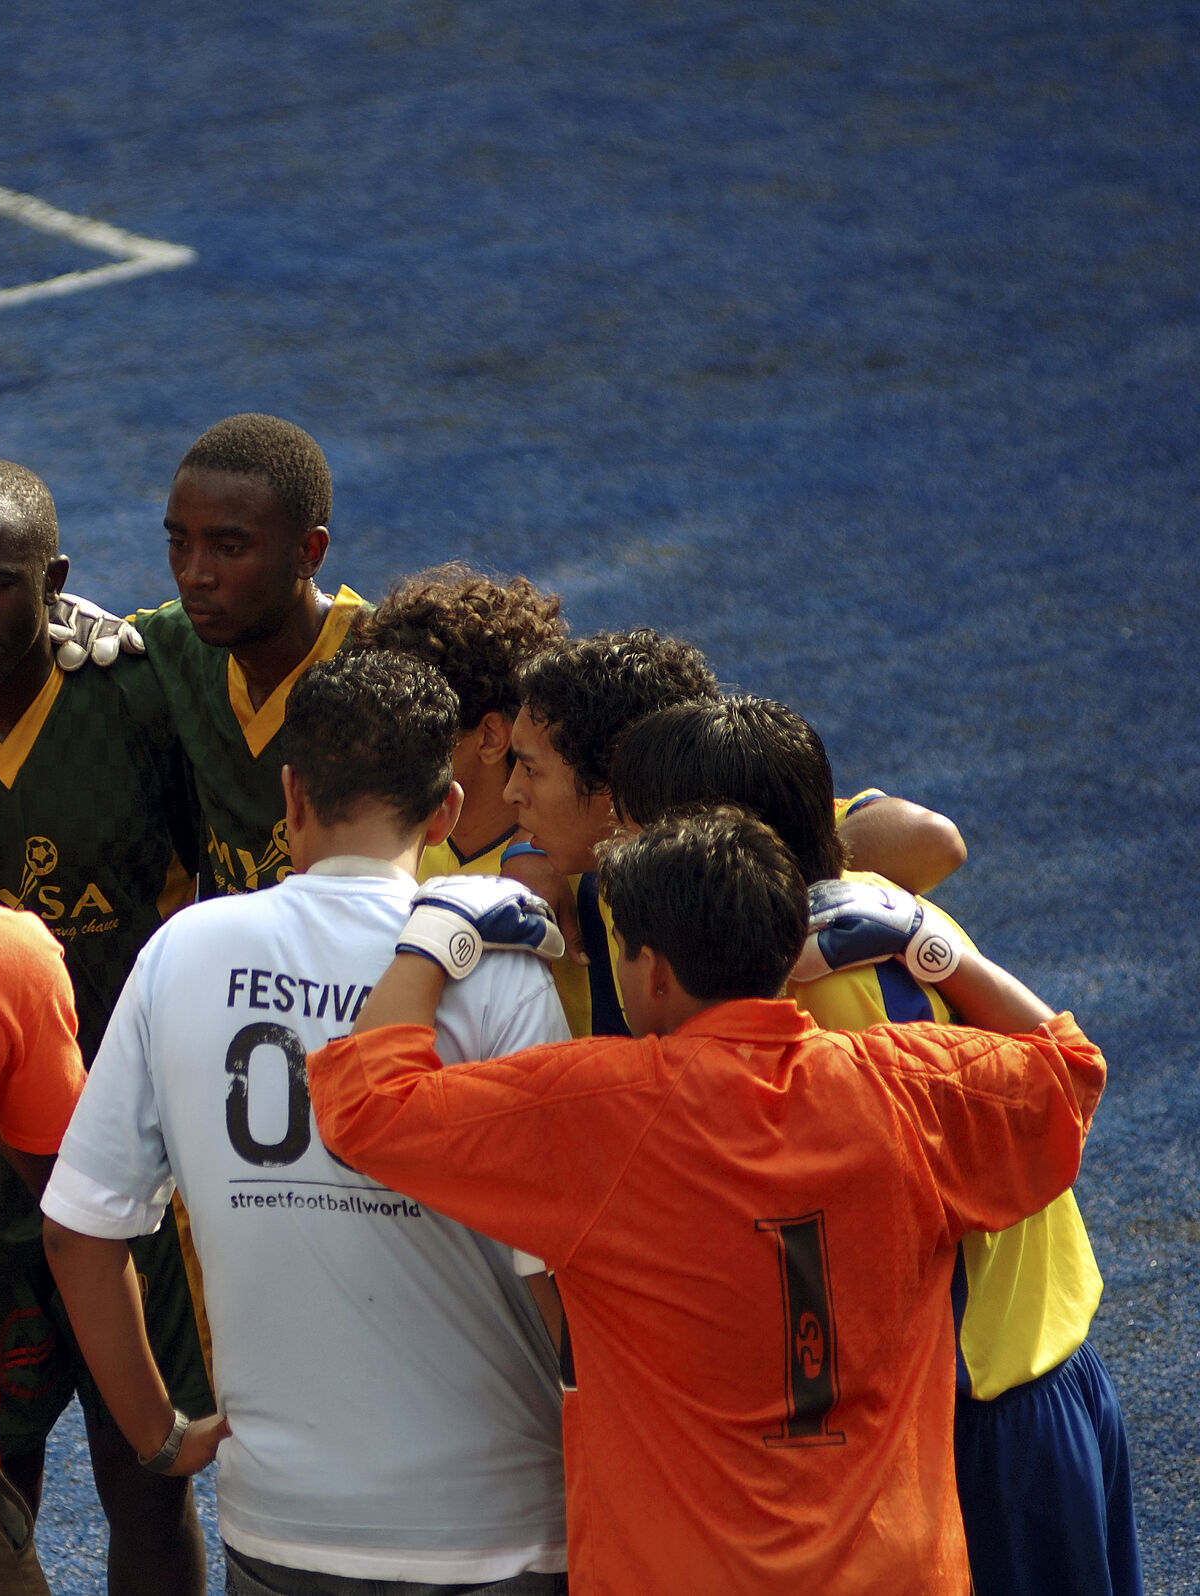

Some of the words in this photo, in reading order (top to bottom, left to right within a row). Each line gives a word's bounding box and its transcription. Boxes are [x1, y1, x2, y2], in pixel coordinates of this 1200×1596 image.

[455, 937, 471, 962] 90
[923, 942, 947, 965] 90
[226, 968, 375, 1023] FESTIVA
[230, 1191, 422, 1218] streetfootballworld
[754, 1209, 847, 1448] 1
